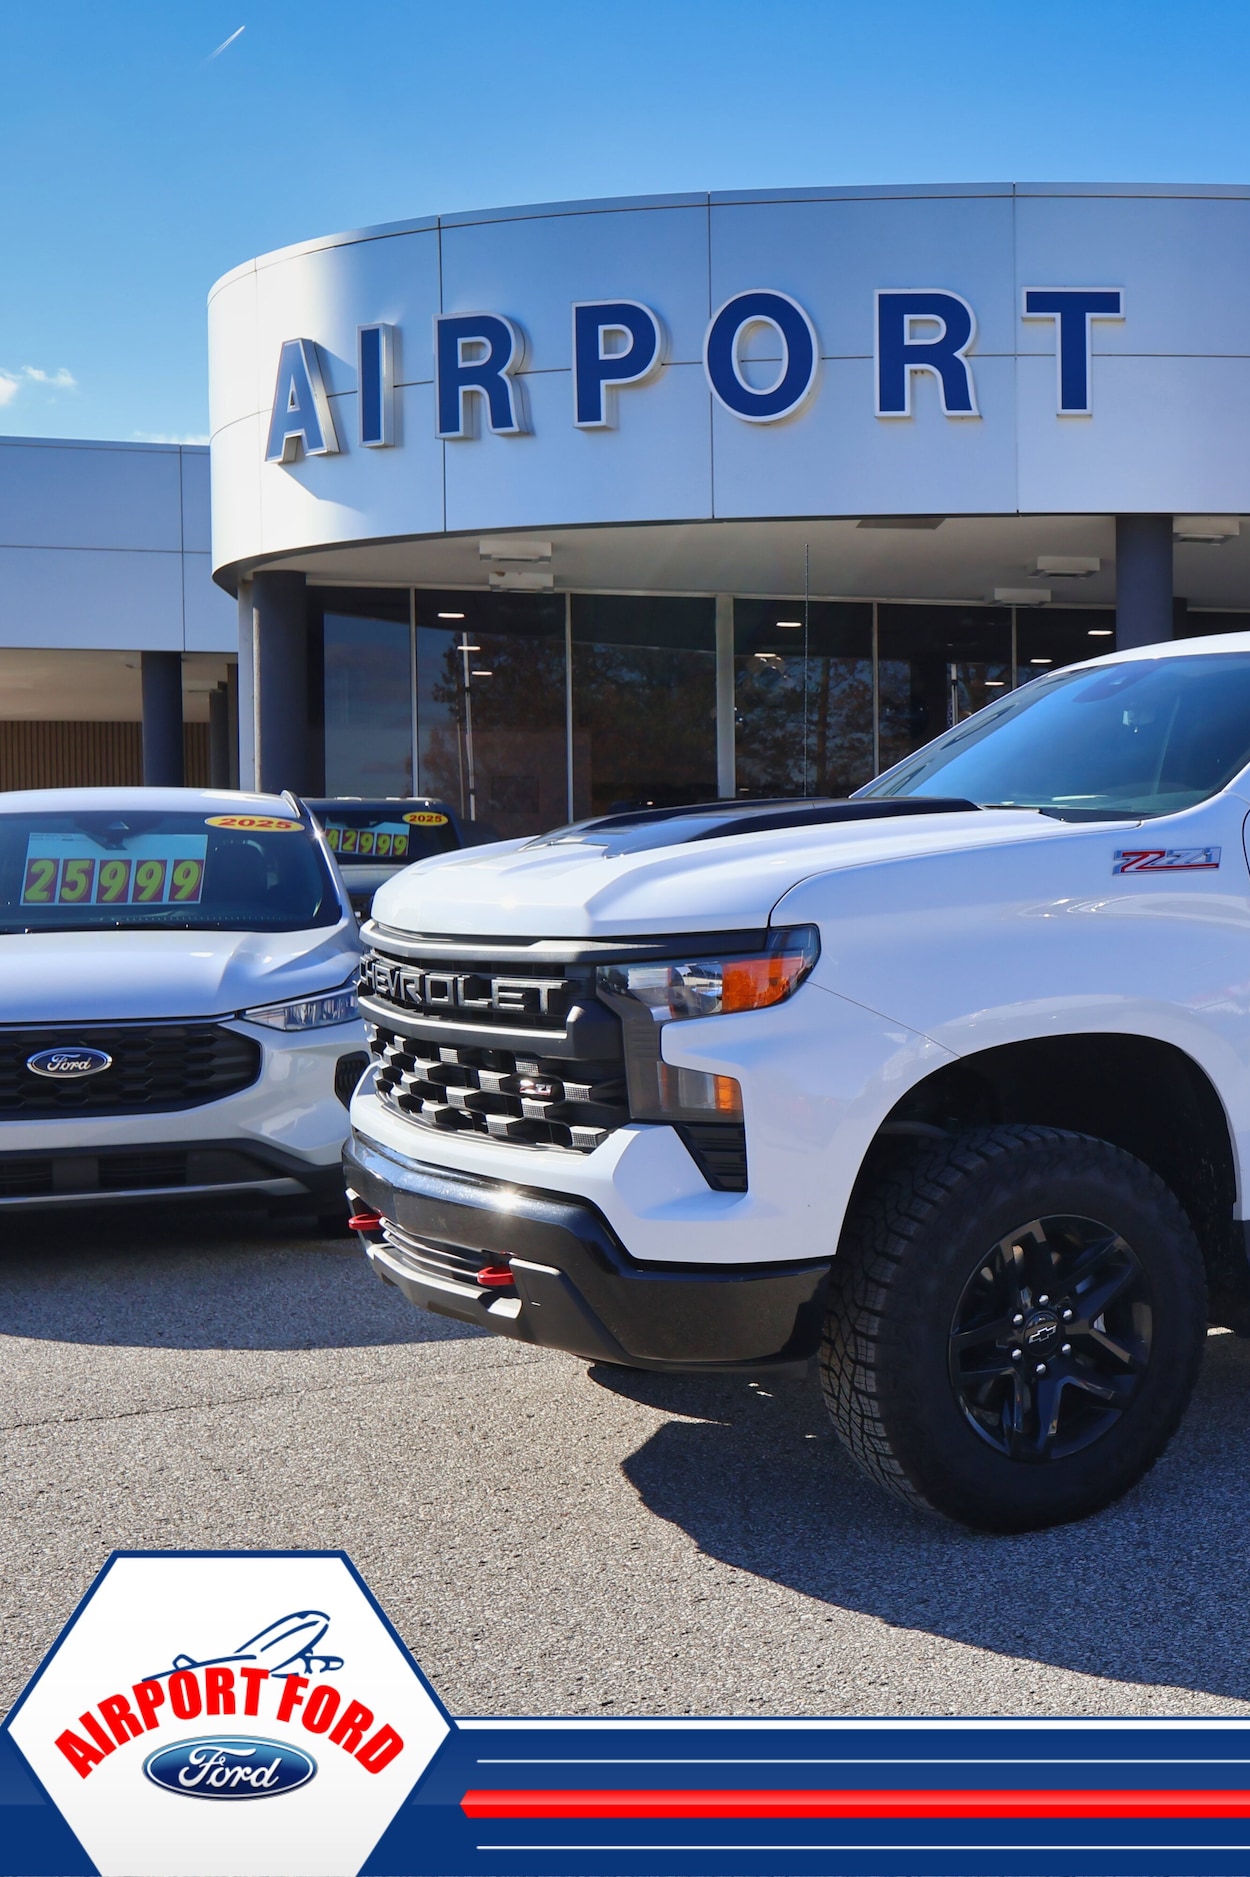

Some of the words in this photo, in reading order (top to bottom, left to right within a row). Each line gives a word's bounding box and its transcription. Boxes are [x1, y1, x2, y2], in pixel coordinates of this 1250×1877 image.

[264, 286, 1126, 464] AIRPORT
[218, 818, 293, 830] 2025
[409, 814, 442, 823] 2025
[327, 829, 407, 856] 42999
[1112, 847, 1222, 876] Z71
[24, 859, 202, 902] 25999
[360, 955, 568, 1015] CHEVROLET
[47, 1054, 92, 1072] Ford
